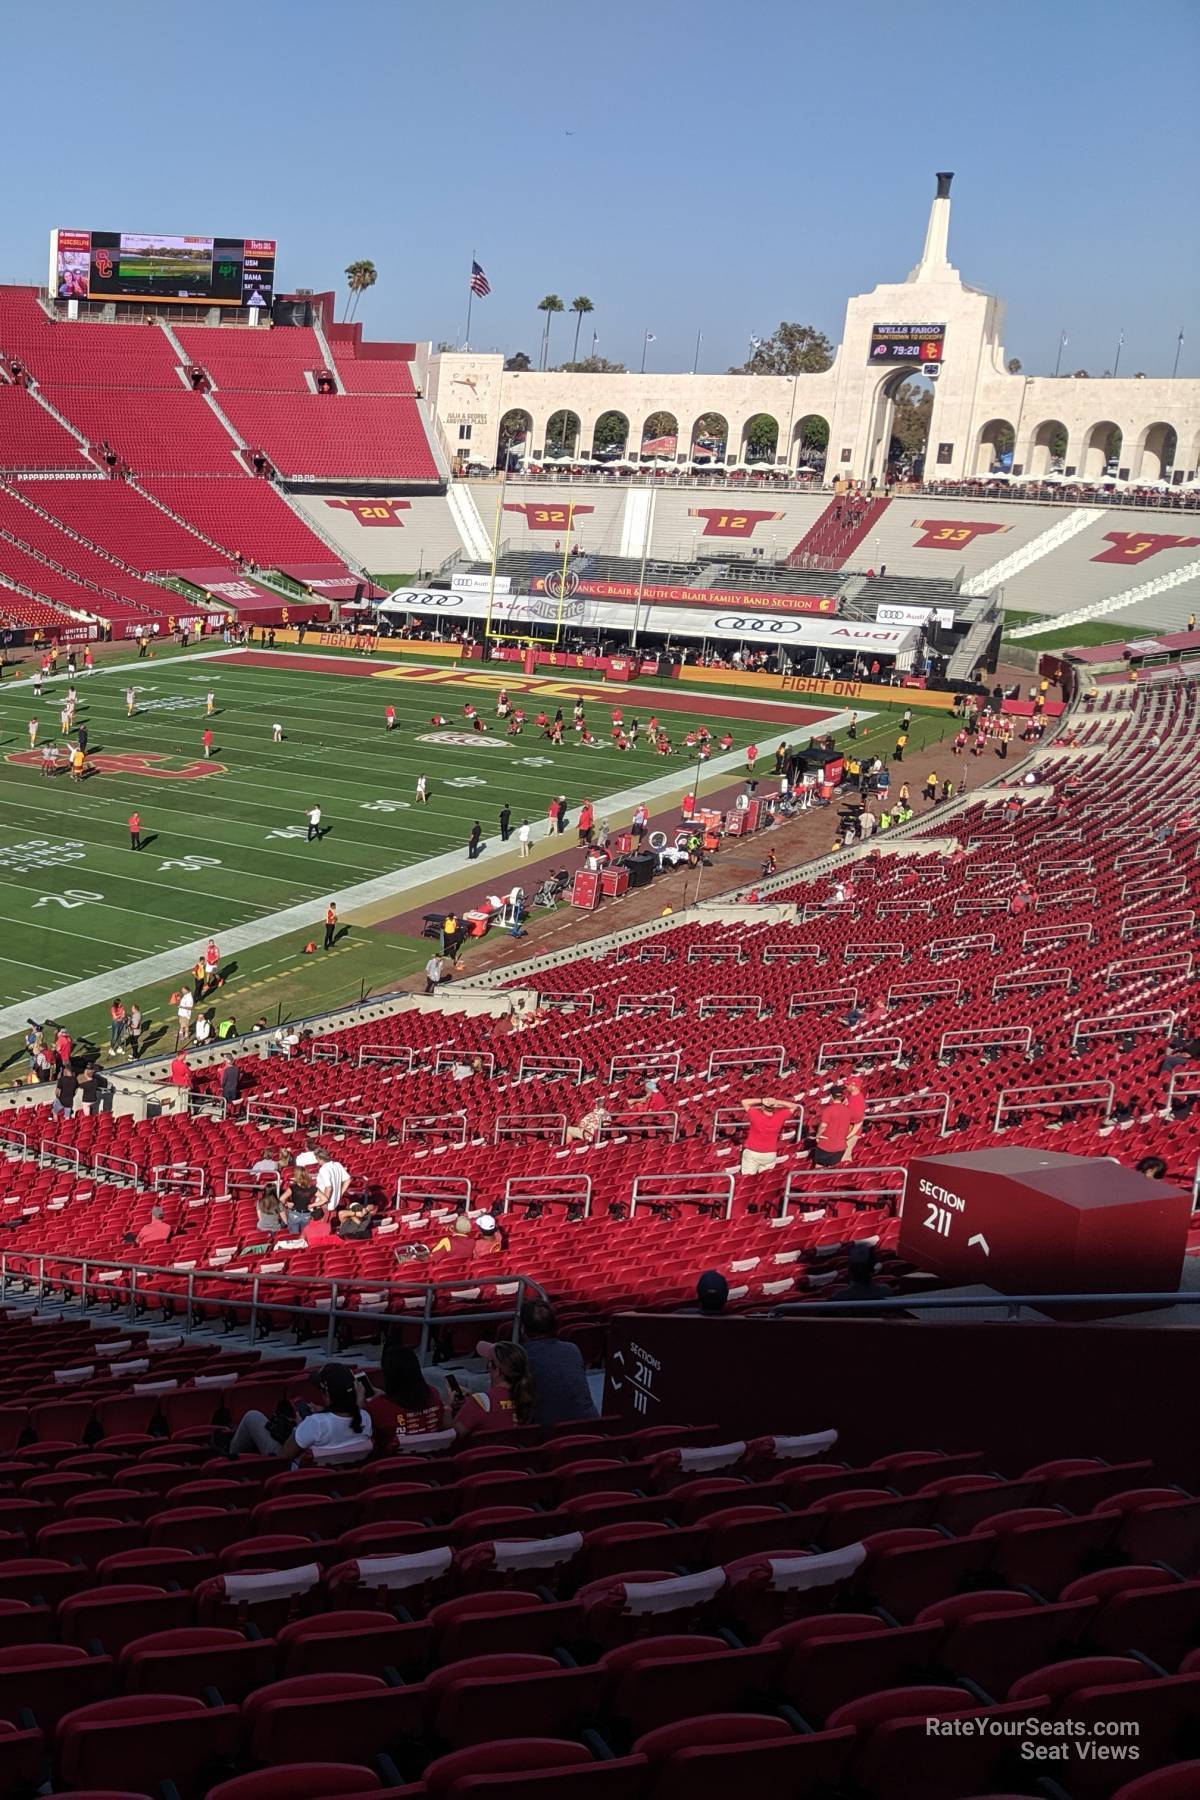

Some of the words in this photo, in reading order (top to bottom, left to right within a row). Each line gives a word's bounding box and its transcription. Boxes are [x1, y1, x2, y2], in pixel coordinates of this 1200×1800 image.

[878, 326, 908, 334] WELLS
[910, 326, 940, 334] FARGO
[358, 507, 389, 519] 20
[535, 511, 565, 523] 32
[716, 517, 747, 529] 12
[932, 528, 972, 541] 33
[1124, 542, 1152, 554] 3
[643, 588, 668, 598] RUTH
[682, 591, 707, 601] BLAIR
[709, 593, 742, 604] FAMILY
[744, 596, 769, 606] BAND
[771, 597, 812, 609] SECTION
[532, 600, 585, 620] Allstate
[64, 626, 88, 634] UNITED
[830, 627, 901, 641] Audi
[319, 633, 355, 648] FIGHT
[371, 666, 629, 700] USC
[781, 676, 830, 694] FIGHT
[833, 682, 863, 697] ON!
[359, 799, 411, 812] 50
[11, 852, 86, 873] FIELD
[161, 855, 223, 871] 30
[37, 889, 105, 909] 20
[919, 1178, 966, 1213] SECTION
[923, 1203, 952, 1238] 211
[630, 1341, 661, 1372] SECTIONS
[634, 1361, 653, 1389] 211
